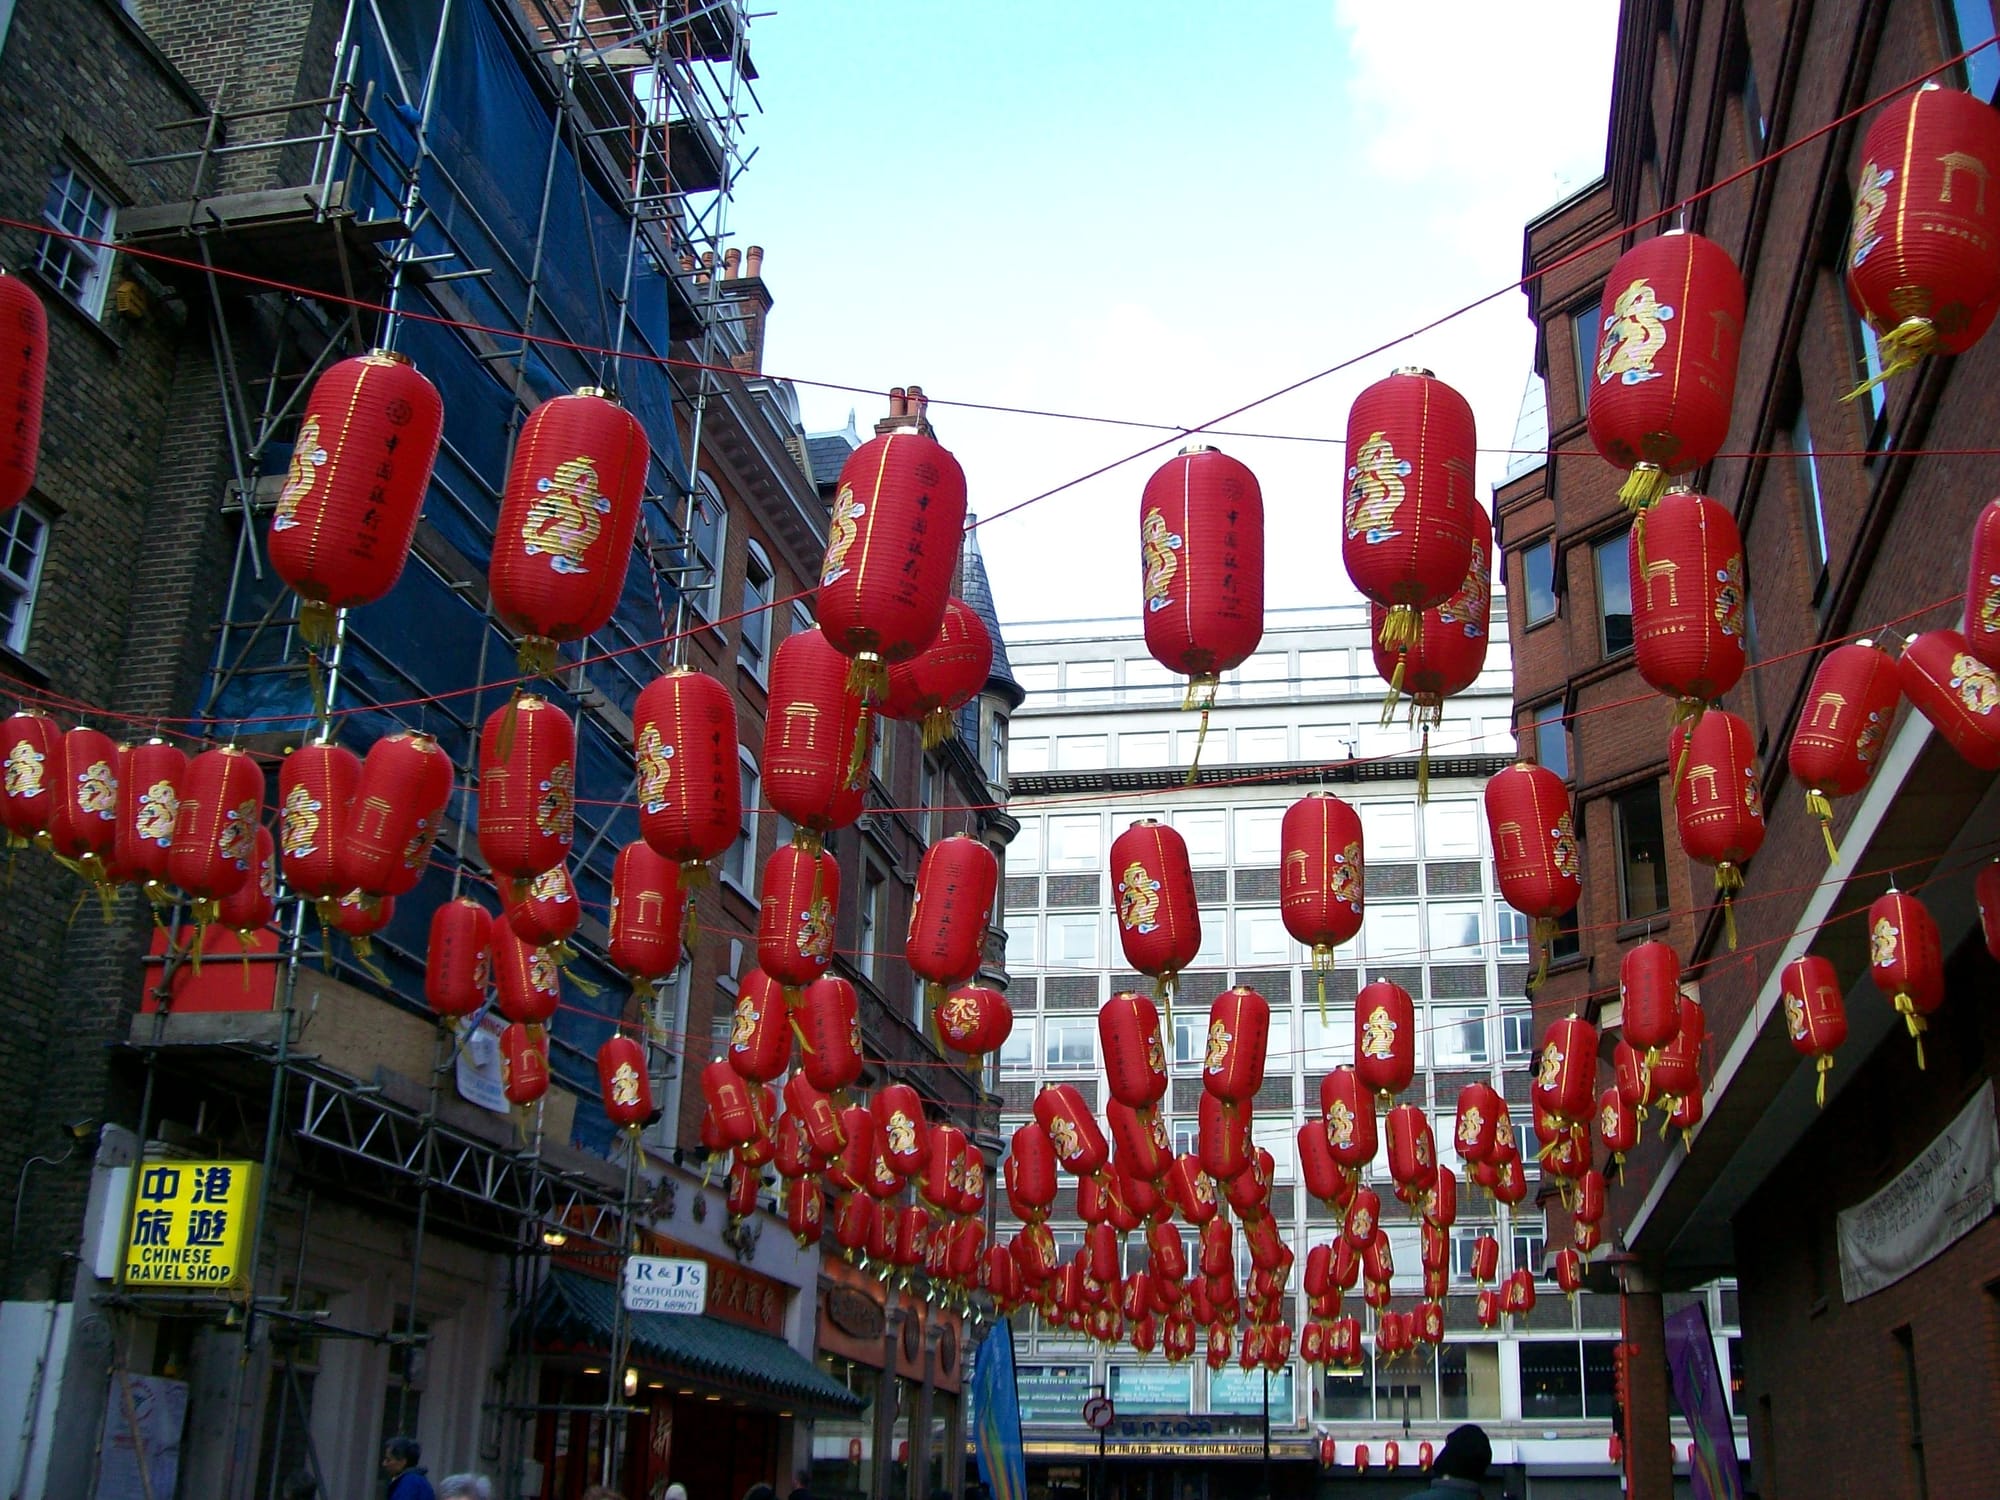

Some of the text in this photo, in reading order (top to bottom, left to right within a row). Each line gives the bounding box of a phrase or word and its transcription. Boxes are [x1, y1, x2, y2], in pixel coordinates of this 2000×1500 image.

[141, 1167, 232, 1204] 中港
[132, 1209, 228, 1246] 旅遊
[142, 1247, 212, 1264] CHINESE
[186, 1265, 230, 1281] SHOP
[635, 1263, 652, 1281] R
[657, 1267, 671, 1278] &
[632, 1284, 700, 1299] SCAFFOLDING
[631, 1296, 698, 1312] 07971 689671
[1094, 1444, 1116, 1454] FOM
[1223, 1444, 1270, 1454] BARCELON
